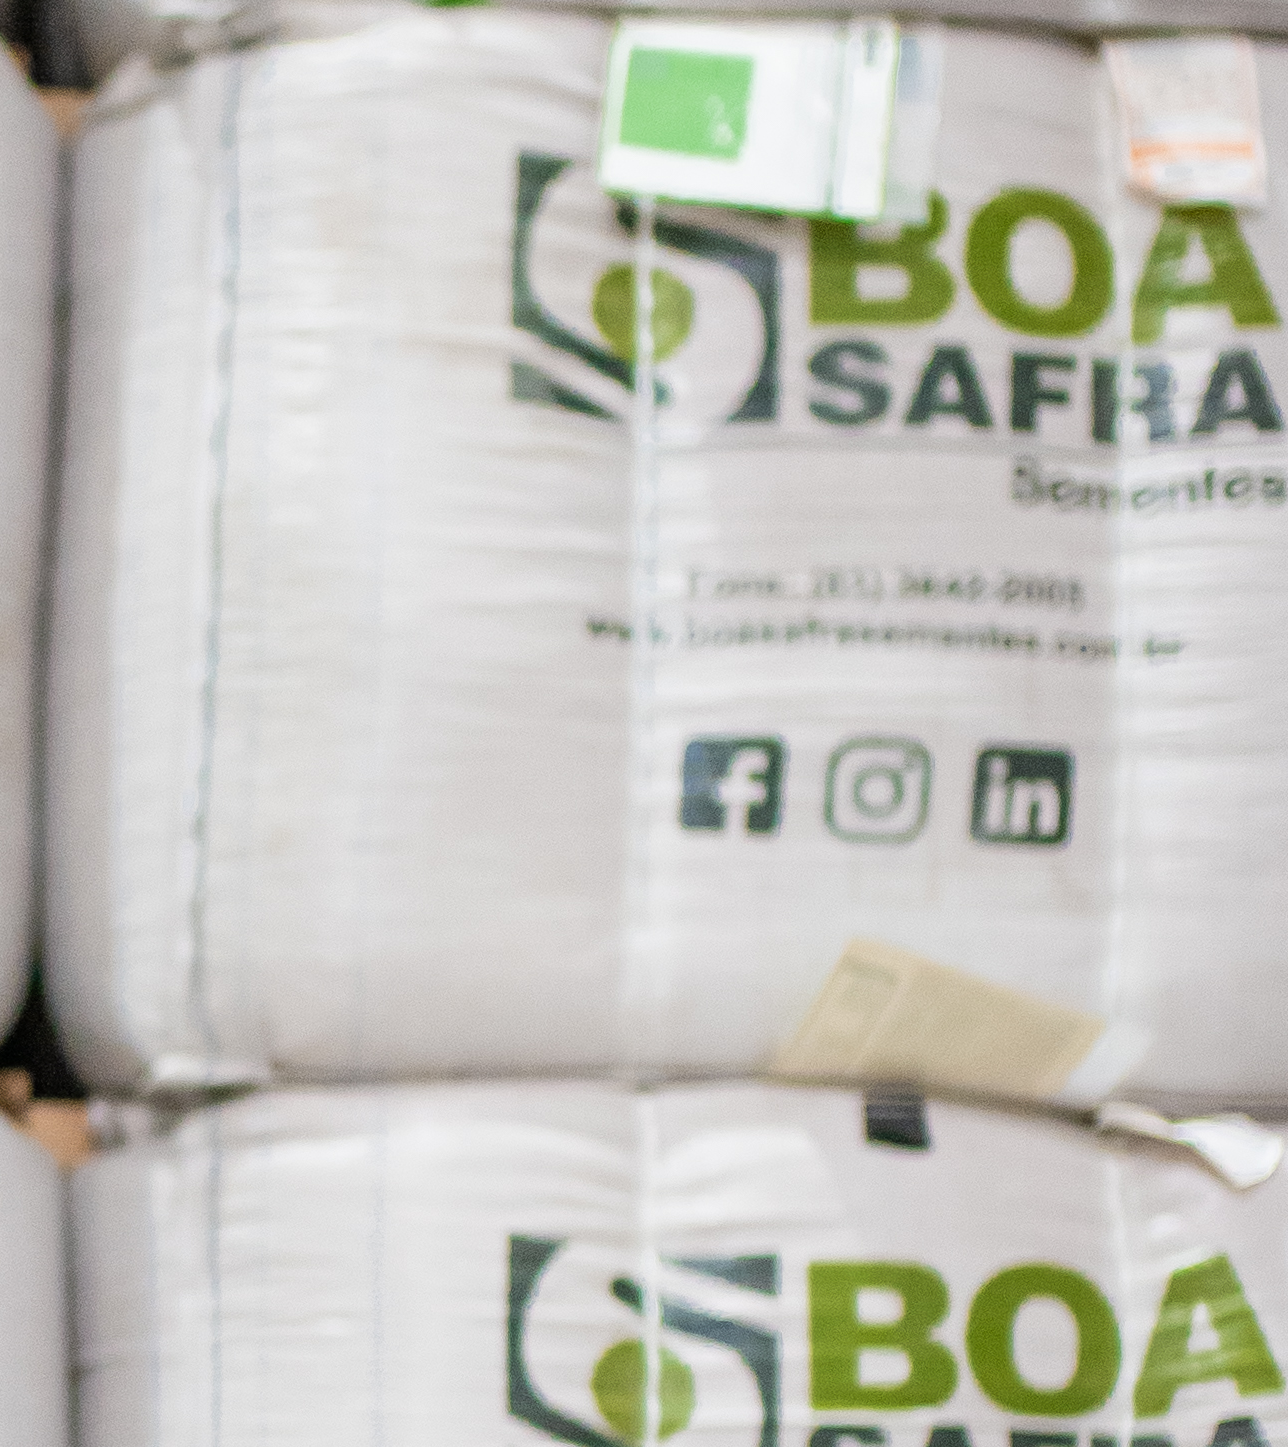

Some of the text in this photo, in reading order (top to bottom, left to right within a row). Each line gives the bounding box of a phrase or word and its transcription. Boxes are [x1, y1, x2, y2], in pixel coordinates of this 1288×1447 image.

[807, 185, 1281, 345] BOA
[806, 340, 1286, 445] SAFRA
[808, 1253, 1286, 1419] BOA
